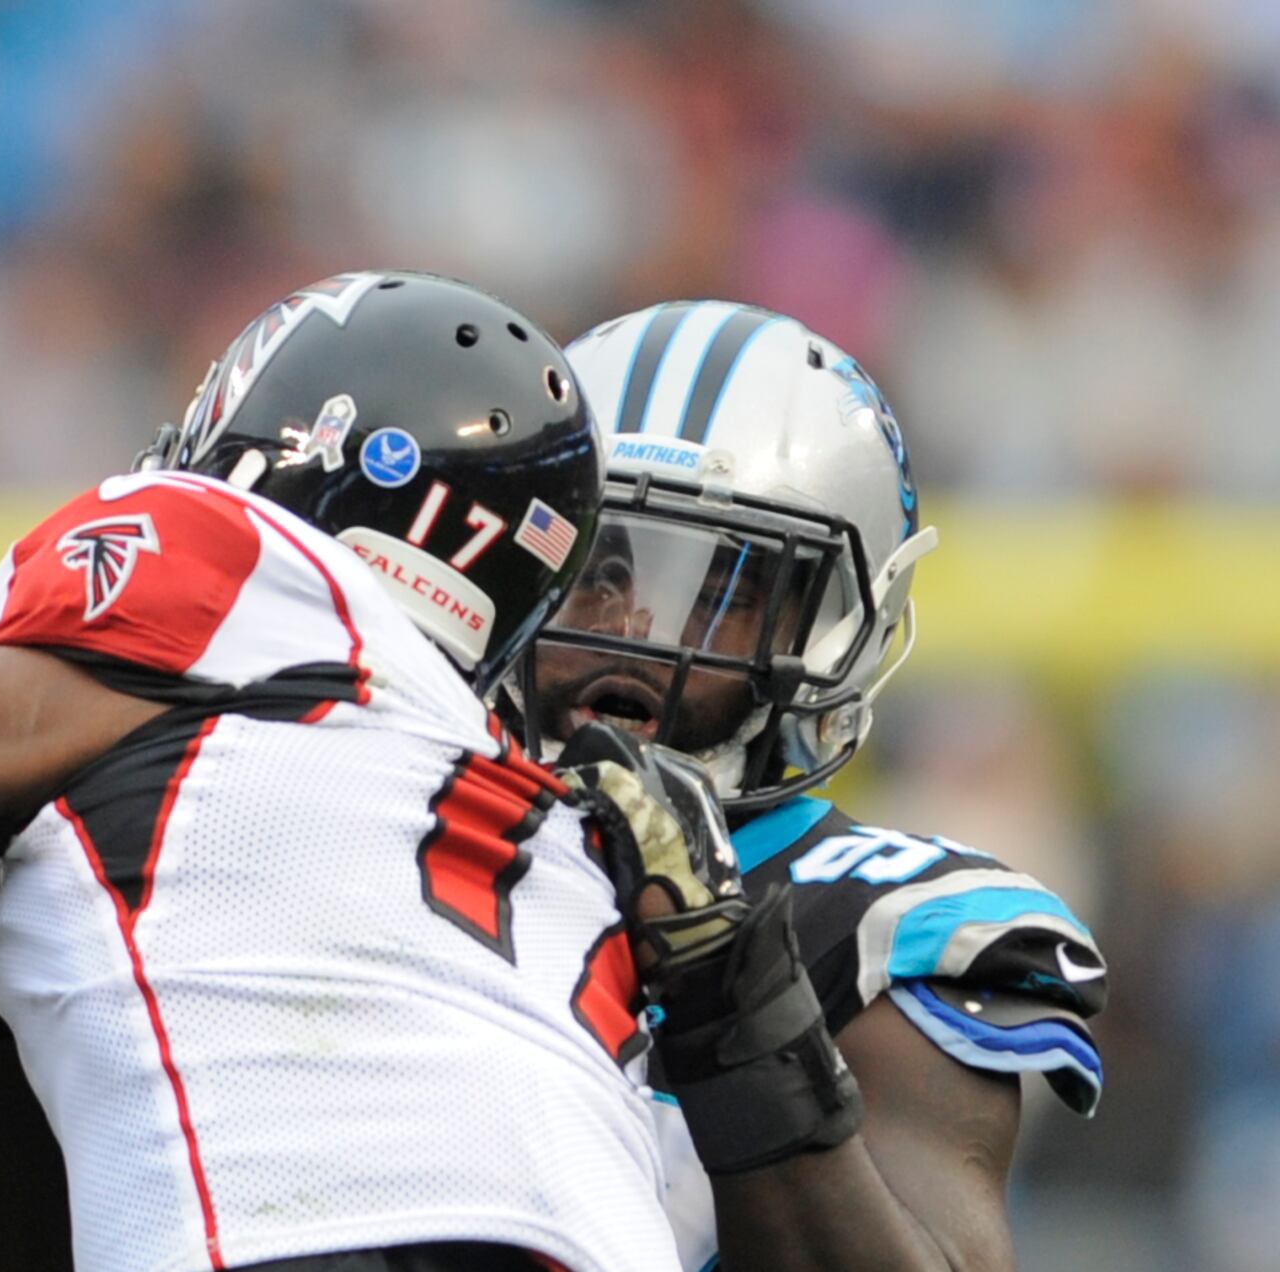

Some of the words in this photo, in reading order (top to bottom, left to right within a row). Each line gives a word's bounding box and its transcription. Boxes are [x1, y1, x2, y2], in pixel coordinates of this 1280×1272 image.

[613, 441, 700, 469] PANTHERS
[405, 478, 508, 573] 17
[351, 543, 486, 632] FALCONS
